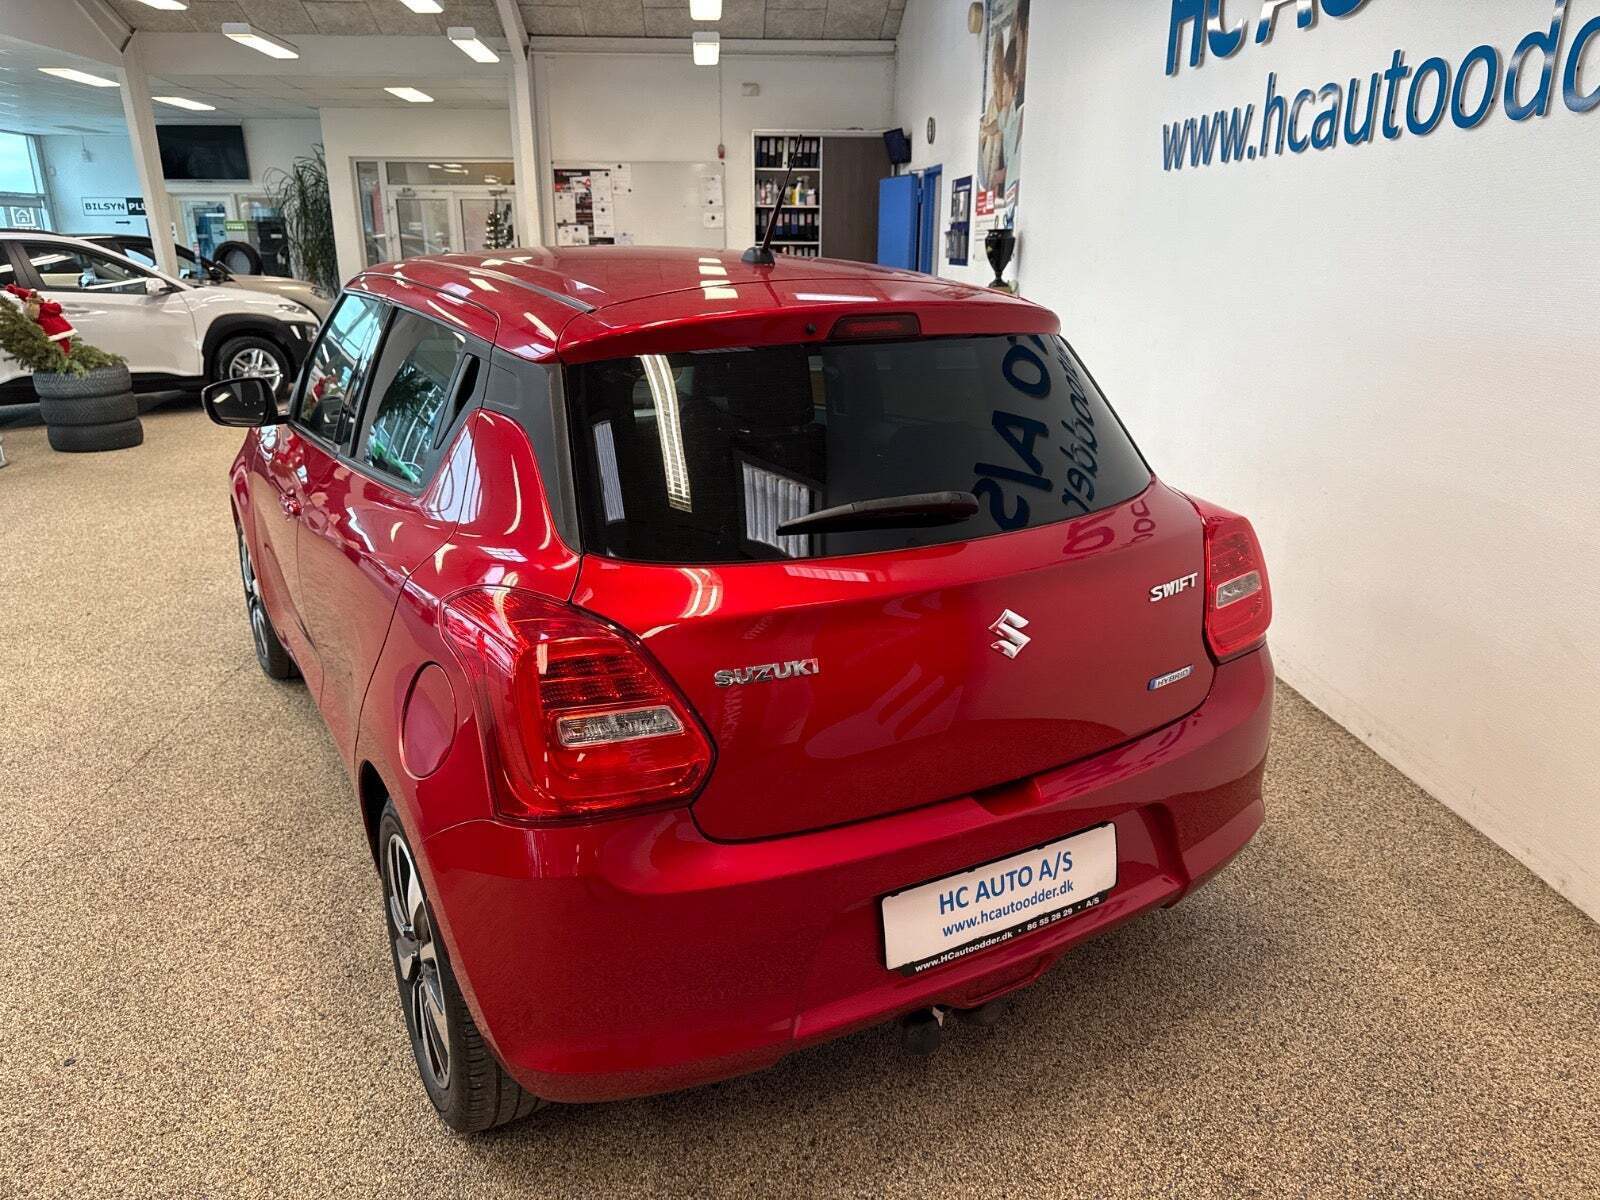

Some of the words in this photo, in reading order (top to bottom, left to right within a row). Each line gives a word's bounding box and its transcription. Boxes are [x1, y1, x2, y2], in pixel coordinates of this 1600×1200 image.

[85, 202, 126, 211] BILSYN
[1149, 571, 1198, 602] SWIFT
[714, 658, 820, 687] SUZUKI
[1157, 669, 1190, 687] HYBRID
[939, 886, 970, 916] HC
[975, 865, 1034, 903] AUTO
[1038, 850, 1074, 881] A/S
[942, 878, 1074, 937] www.hcautoodder.dk
[914, 931, 1014, 972] www.HCautoodder.dk
